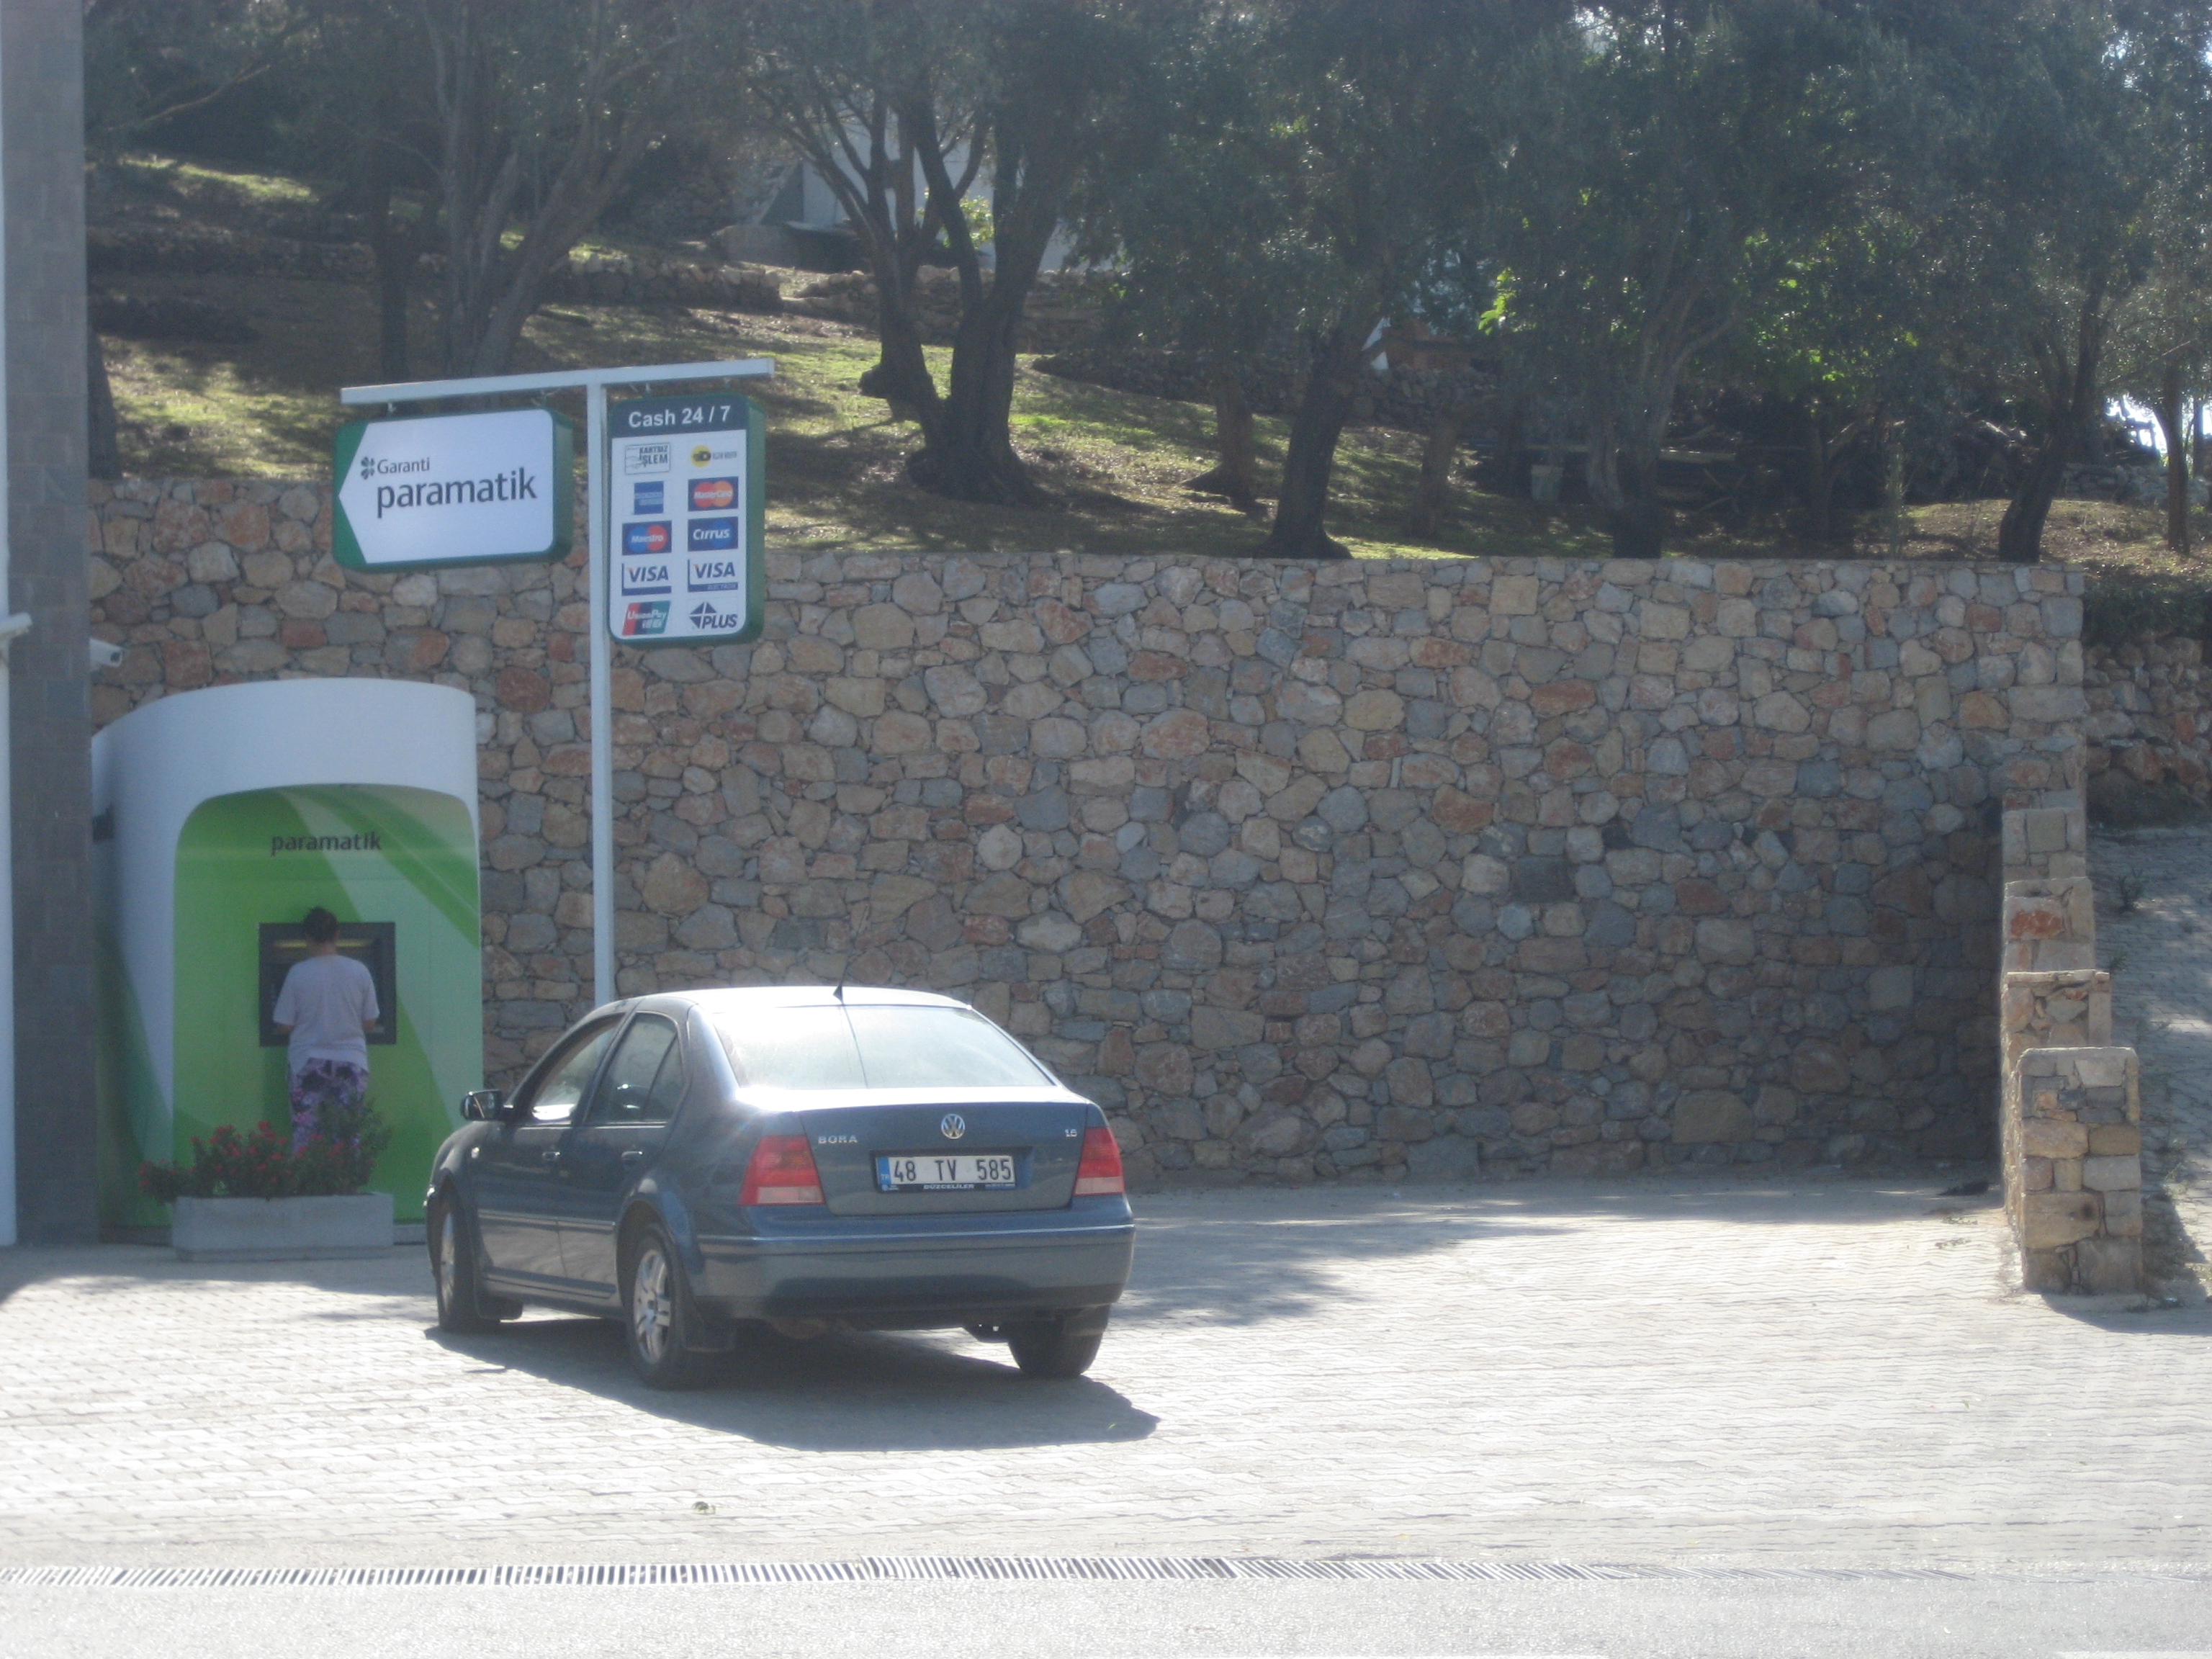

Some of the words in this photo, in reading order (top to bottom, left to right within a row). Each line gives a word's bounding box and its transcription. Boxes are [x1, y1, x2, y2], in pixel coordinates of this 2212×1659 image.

[628, 409, 676, 428] Cash
[377, 457, 431, 474] Garanti
[377, 467, 538, 518] paramatik
[693, 528, 730, 540] Cirrus
[628, 565, 669, 583] VISA
[694, 562, 735, 578] VISA
[701, 613, 738, 629] PLUS
[271, 831, 382, 856] paramatik
[818, 1136, 858, 1144] BORA
[894, 1160, 917, 1182] 48
[935, 1159, 957, 1181] TV
[977, 1159, 1012, 1181] 585
